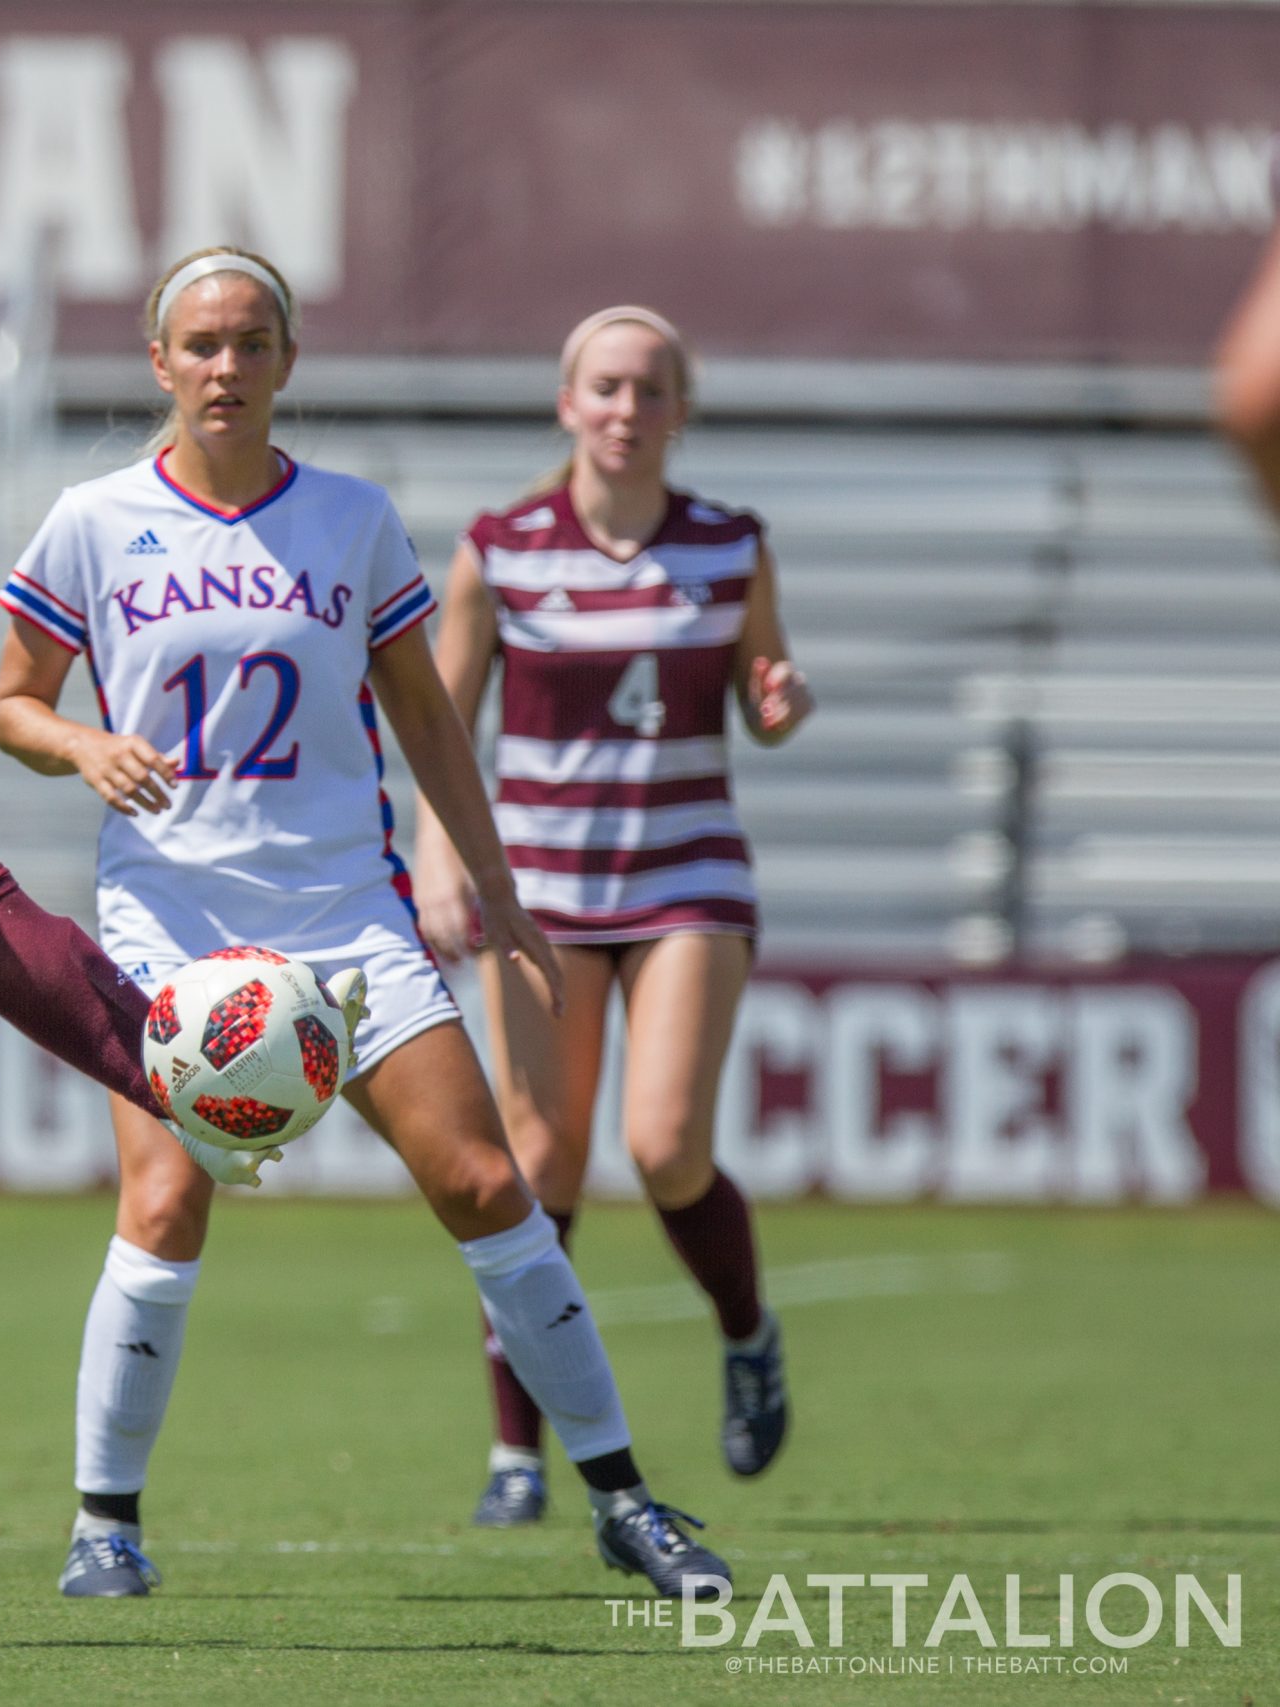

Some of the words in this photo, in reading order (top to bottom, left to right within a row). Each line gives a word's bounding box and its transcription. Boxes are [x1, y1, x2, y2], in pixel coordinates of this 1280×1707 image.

[113, 566, 352, 635] KANSAS
[163, 651, 301, 780] 12
[608, 652, 667, 738] 4
[173, 1063, 202, 1094] adidas
[223, 1049, 259, 1080] TELSTAR
